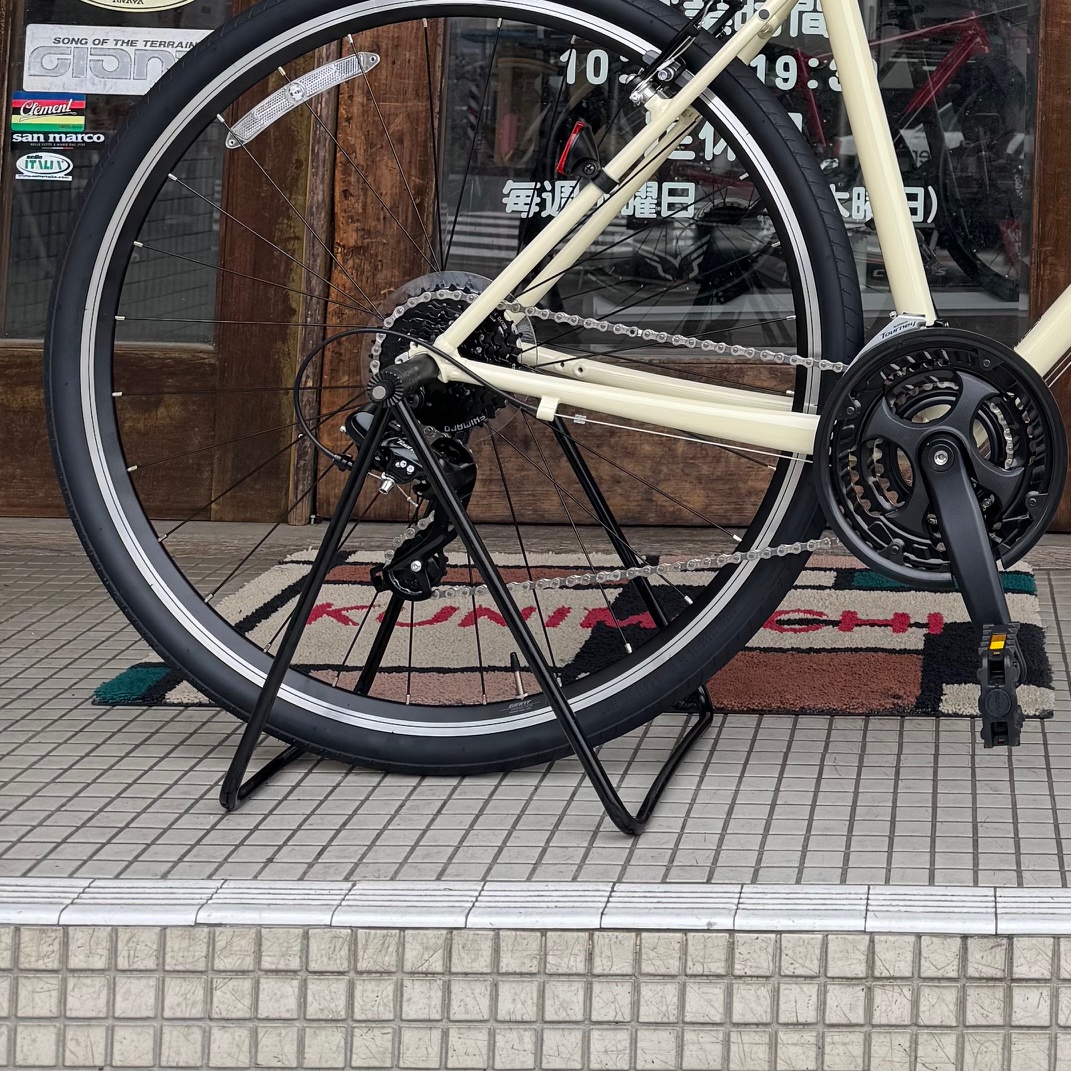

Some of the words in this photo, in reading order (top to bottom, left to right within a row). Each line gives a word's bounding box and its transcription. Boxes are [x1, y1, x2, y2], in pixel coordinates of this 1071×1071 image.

[53, 37, 88, 45] SONG
[93, 38, 109, 46] OF
[113, 39, 138, 47] THE
[12, 133, 45, 142] san
[48, 133, 105, 143] marco
